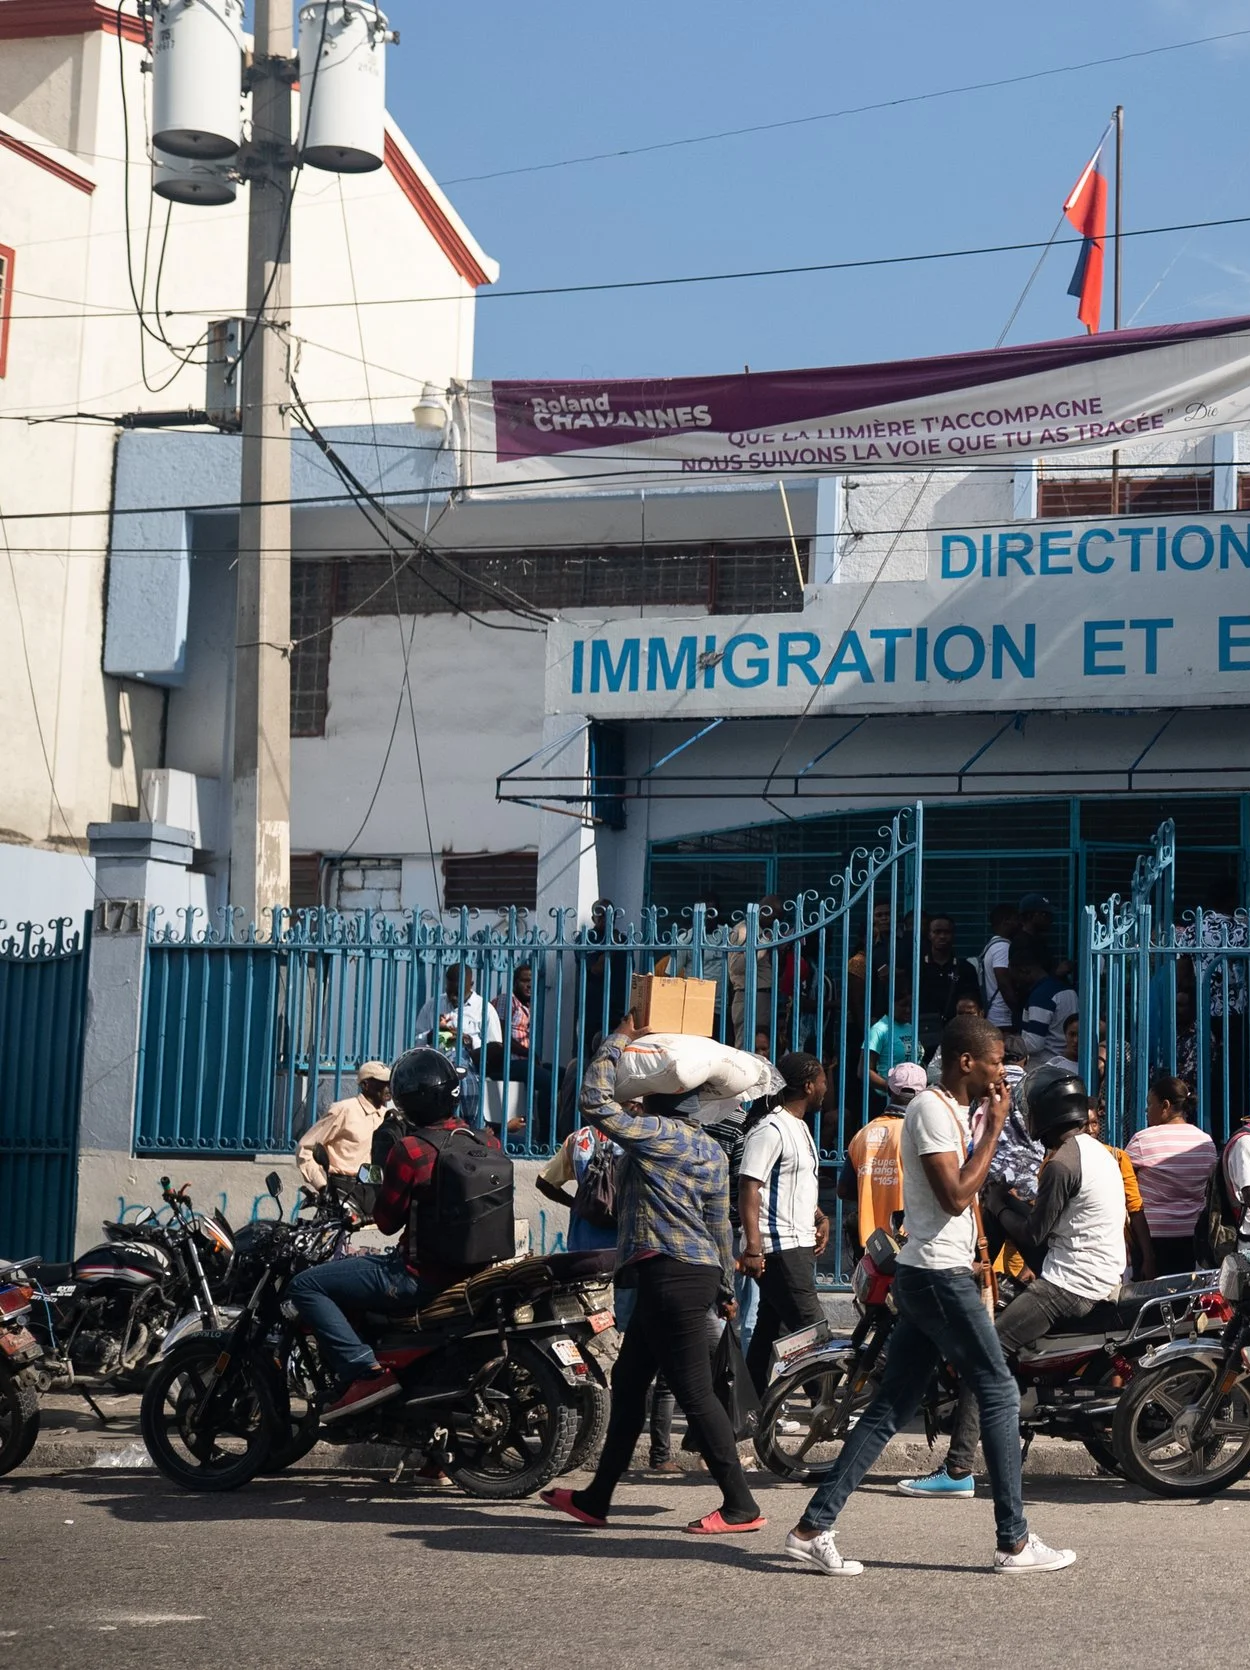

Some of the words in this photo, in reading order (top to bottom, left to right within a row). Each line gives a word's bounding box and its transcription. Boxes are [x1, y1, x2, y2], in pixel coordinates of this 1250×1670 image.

[530, 392, 611, 414] Roland
[533, 405, 713, 432] CHAVANNES
[728, 431, 775, 448] QUE
[817, 419, 917, 440] LUMIÈRE
[920, 397, 1103, 433] T'ACCOMPAGNE
[681, 454, 743, 474] NOUS
[749, 445, 848, 470] SUIVONS
[852, 443, 882, 461] LA
[887, 438, 943, 458] VOIE
[947, 434, 997, 455] QUE
[1002, 431, 1033, 448] TU
[1039, 426, 1070, 445] AS
[571, 623, 1037, 695] IMMIGRATION
[1083, 617, 1174, 676] ET
